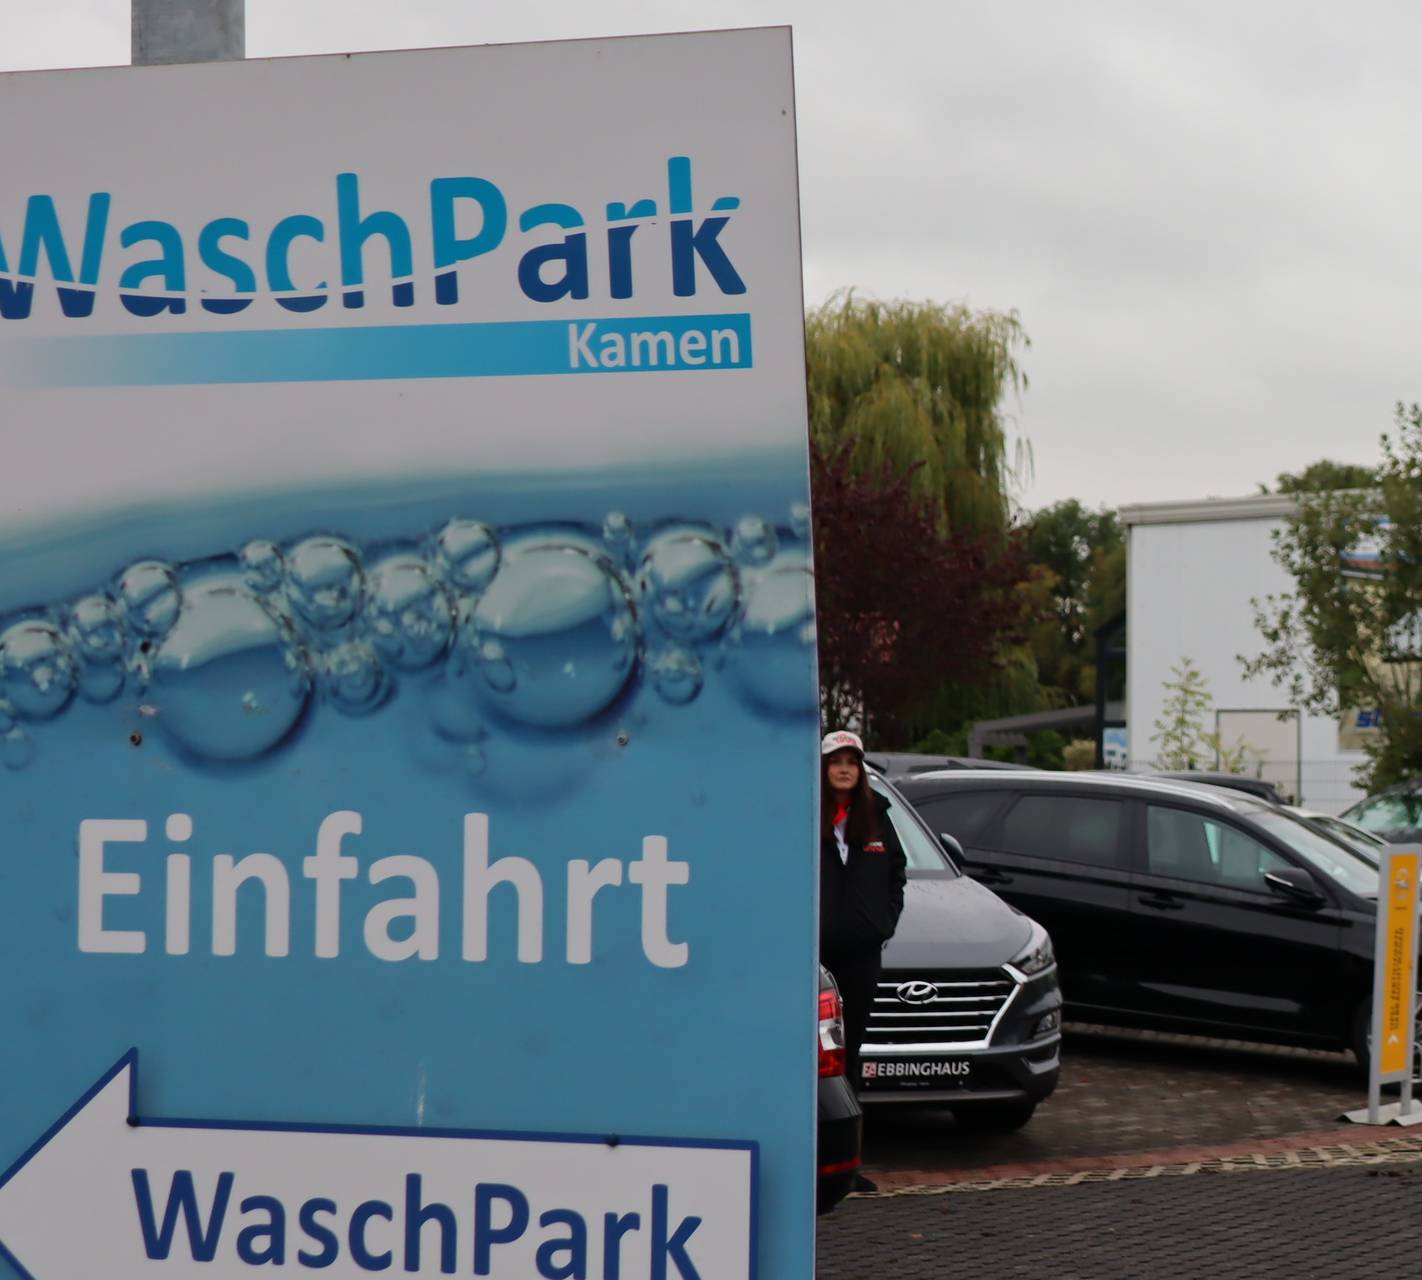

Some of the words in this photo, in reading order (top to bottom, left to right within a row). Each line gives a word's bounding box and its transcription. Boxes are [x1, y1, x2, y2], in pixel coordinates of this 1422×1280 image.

[0, 156, 747, 320] WaschPark
[568, 322, 741, 369] Kamen
[78, 810, 690, 969] Einfahrt
[877, 1061, 970, 1076] EBBINGHAUS
[130, 1167, 703, 1280] WaschPark
